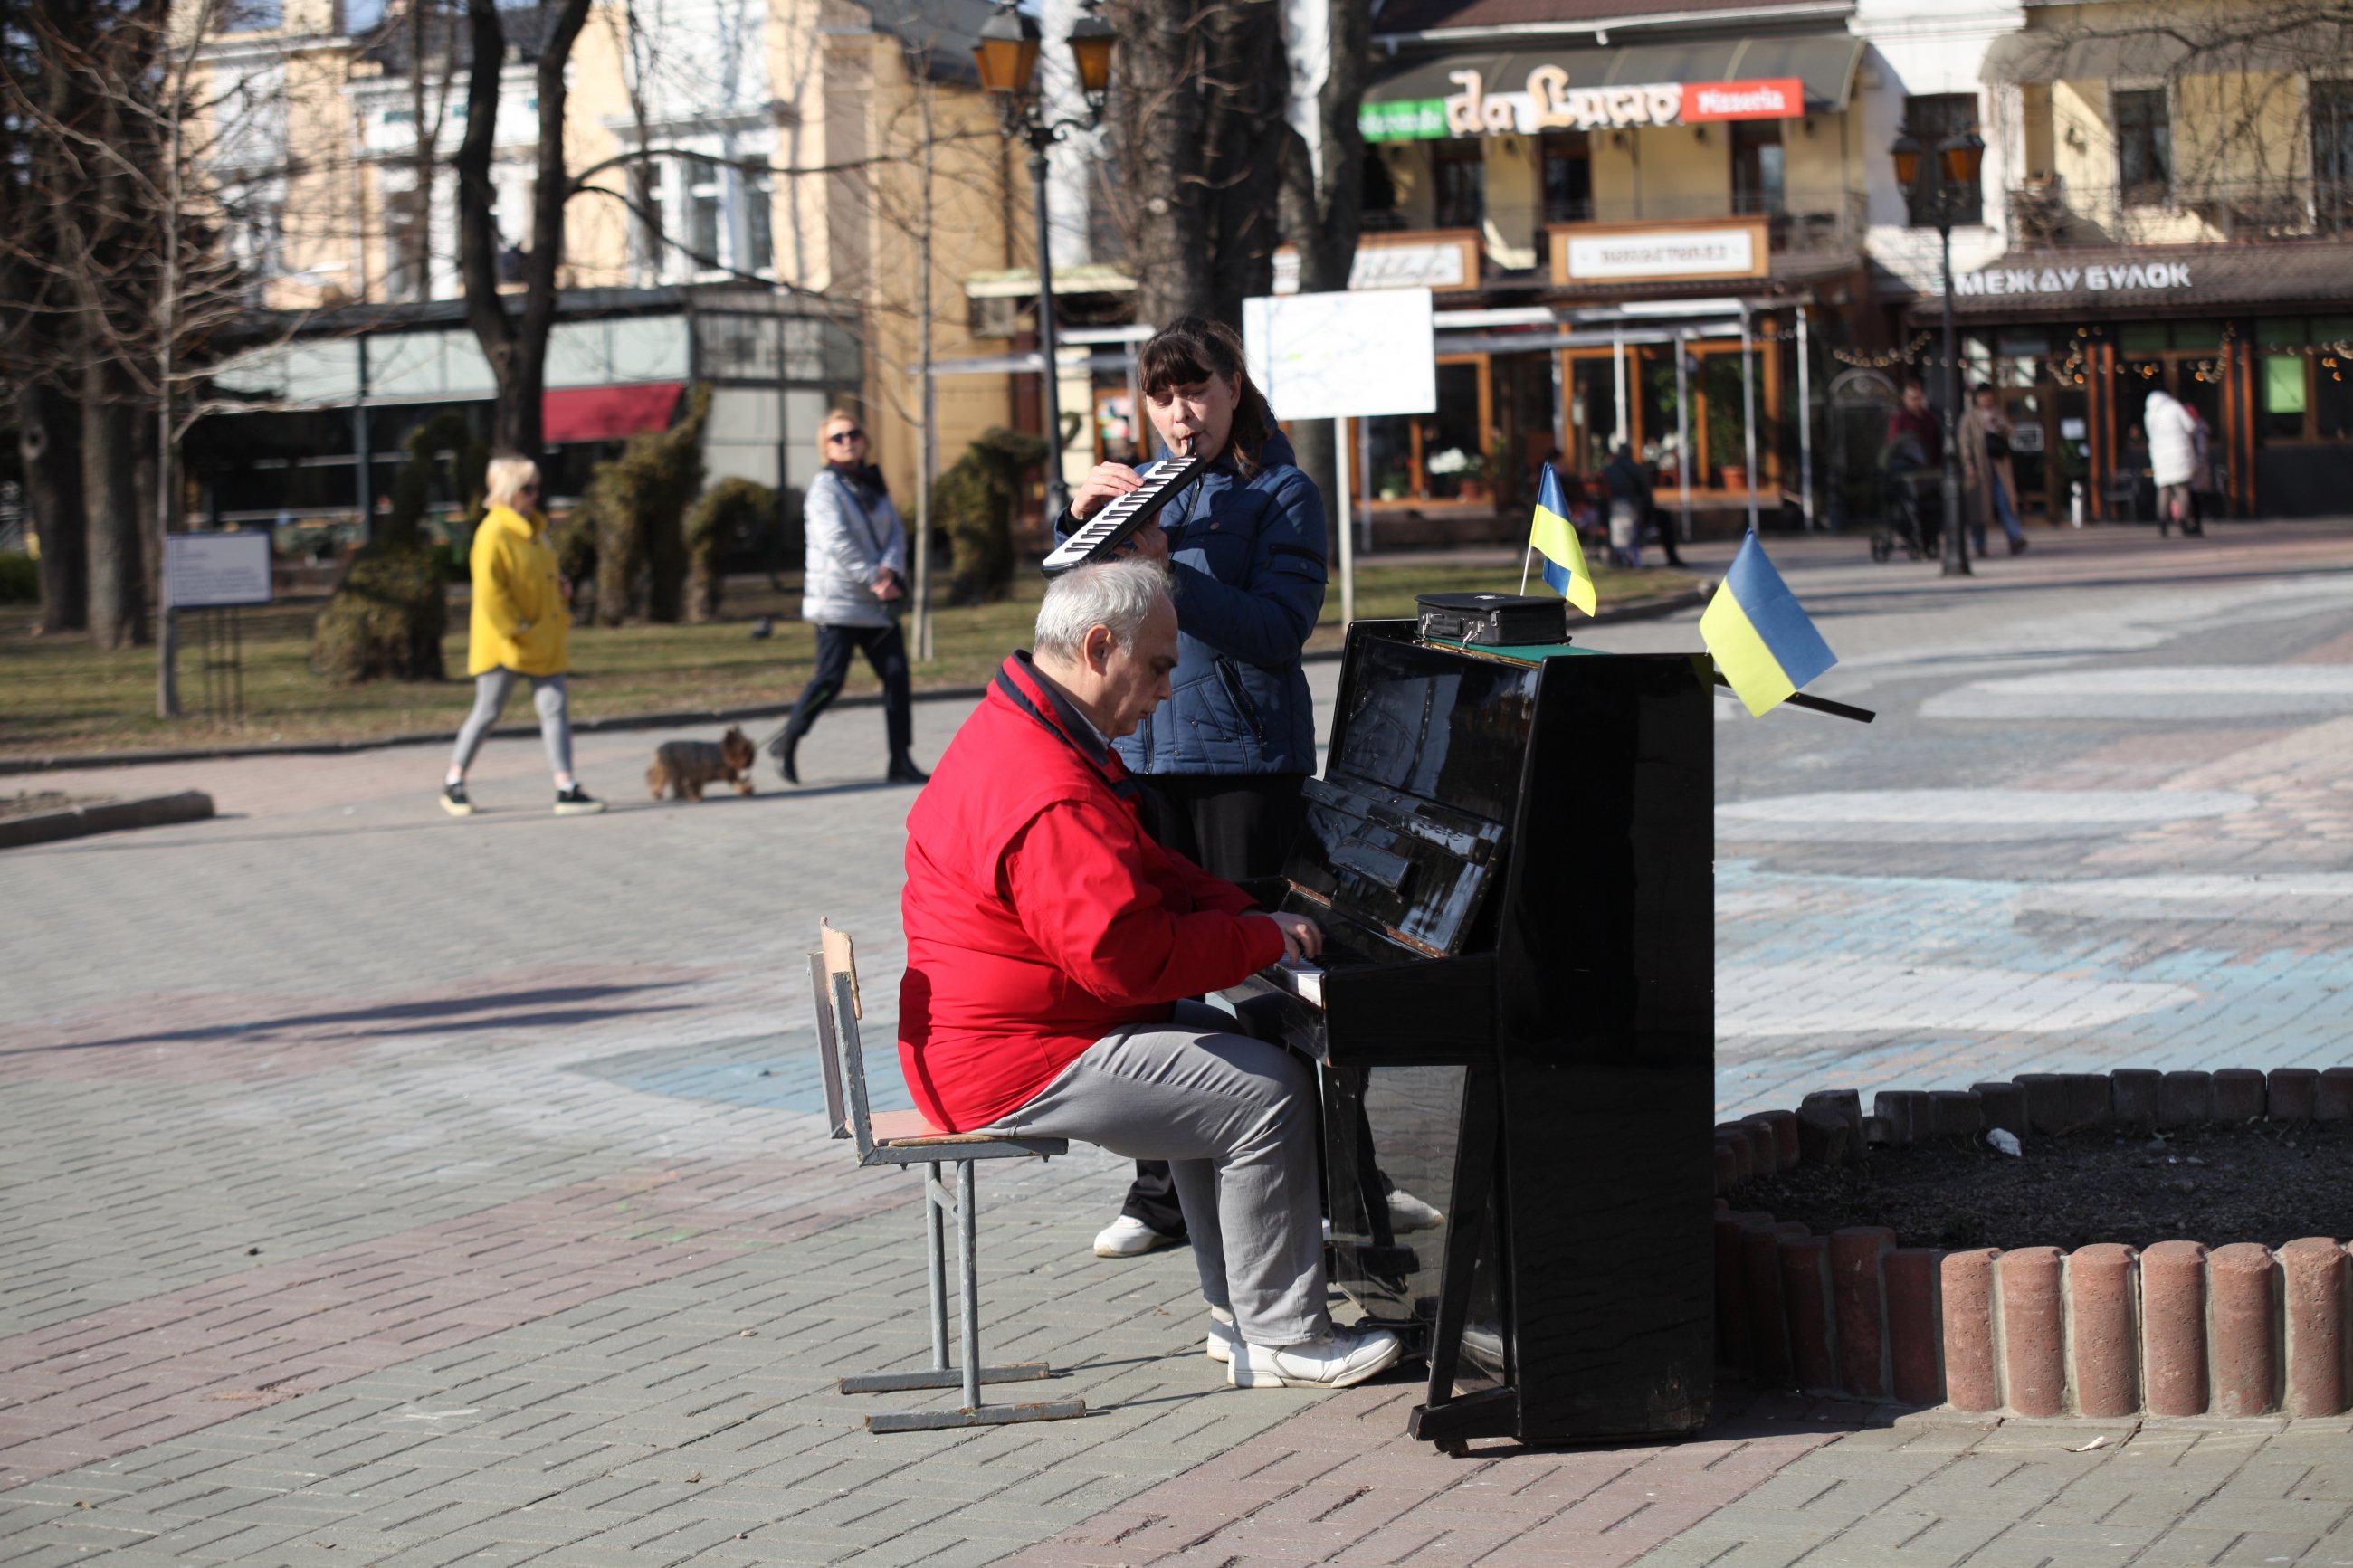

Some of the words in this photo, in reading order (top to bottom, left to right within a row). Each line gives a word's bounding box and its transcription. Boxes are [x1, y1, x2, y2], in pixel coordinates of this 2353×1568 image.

[1447, 69, 1516, 136] da
[1953, 266, 2081, 297] МЕЖДУ
[2084, 261, 2192, 291] БУЛОК
